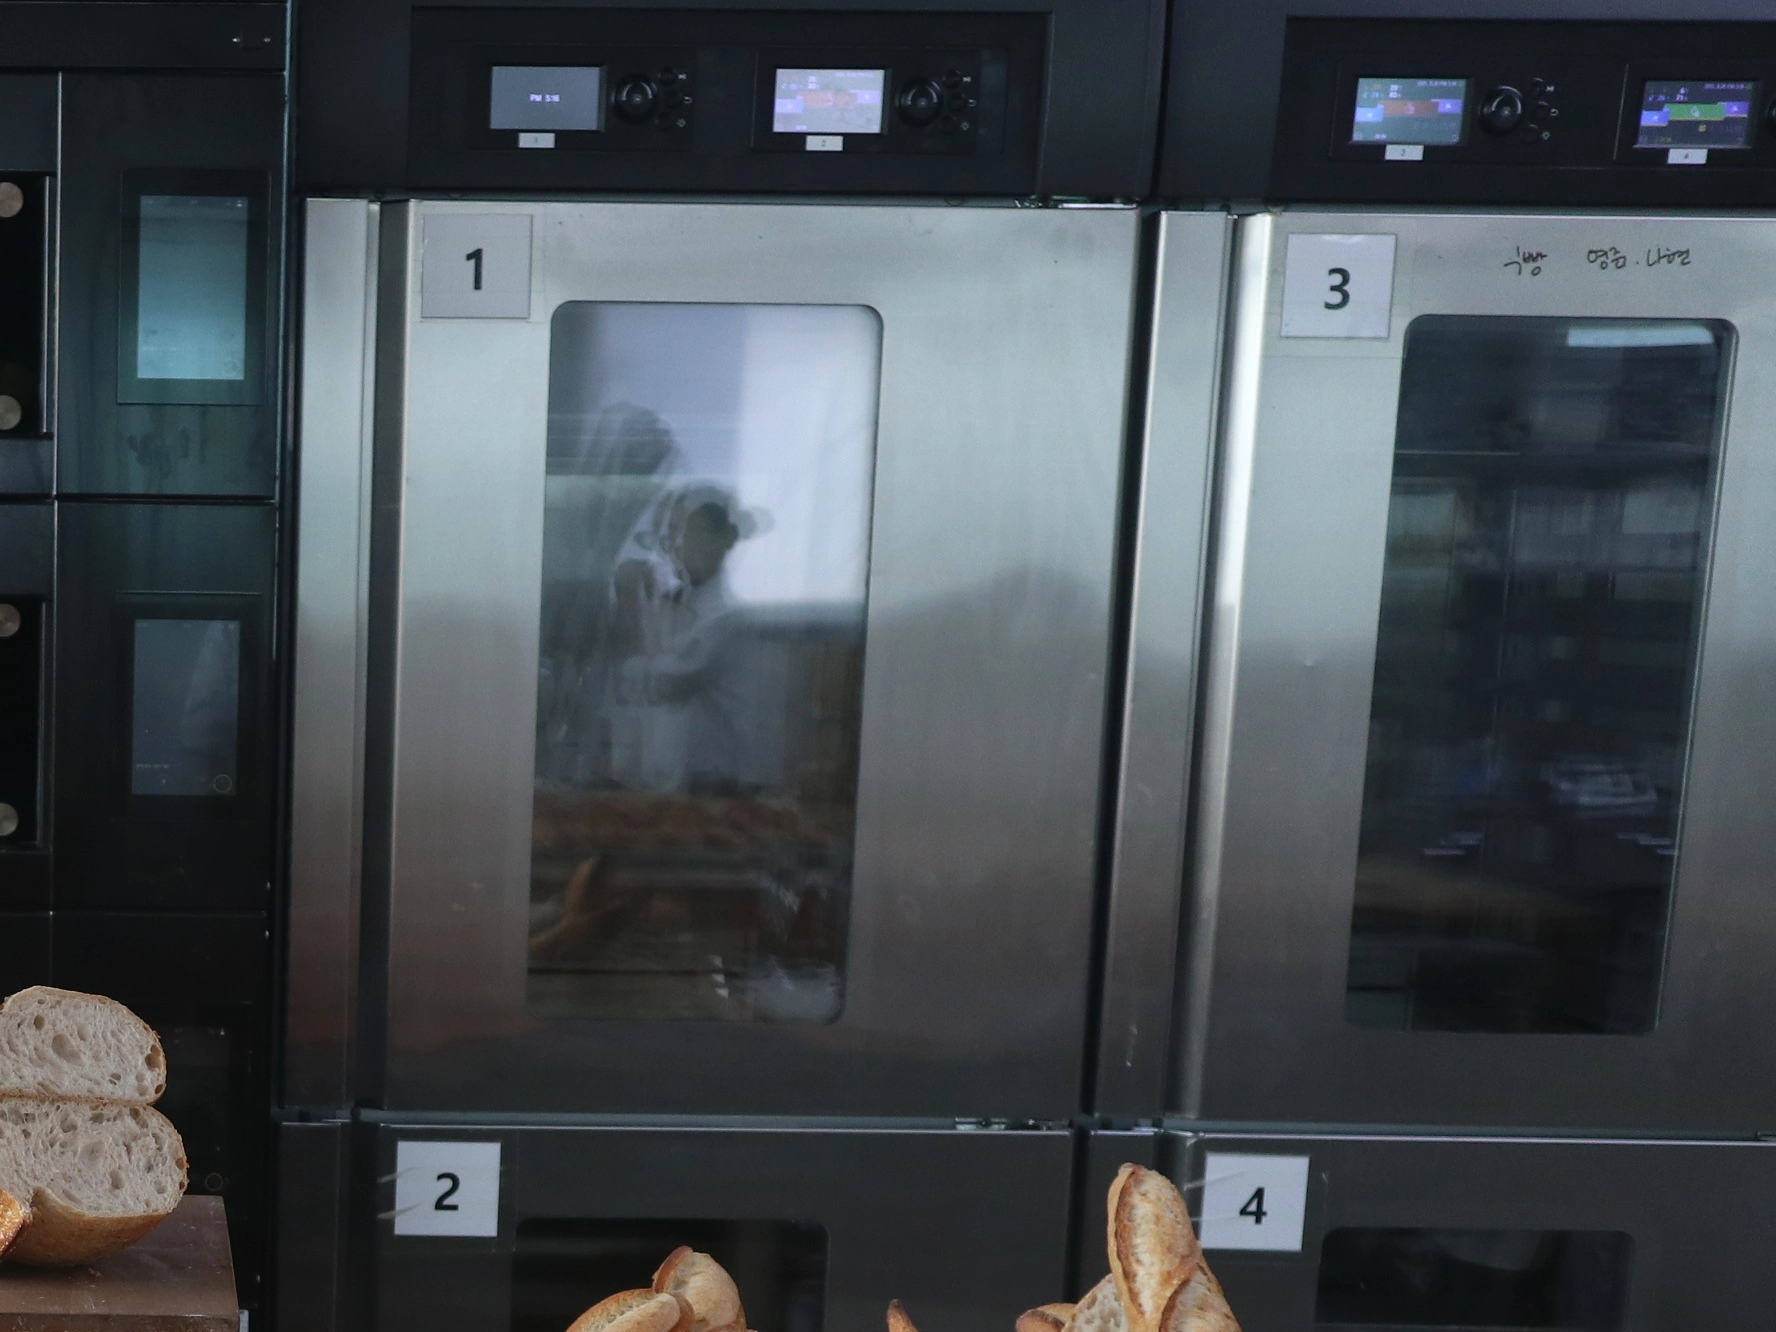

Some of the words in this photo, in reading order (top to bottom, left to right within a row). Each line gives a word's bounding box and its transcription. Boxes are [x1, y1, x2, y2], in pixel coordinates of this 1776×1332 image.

[466, 248, 483, 290] 1
[1324, 267, 1350, 310] 3
[434, 1172, 460, 1211] 2
[1239, 1186, 1267, 1225] 4
